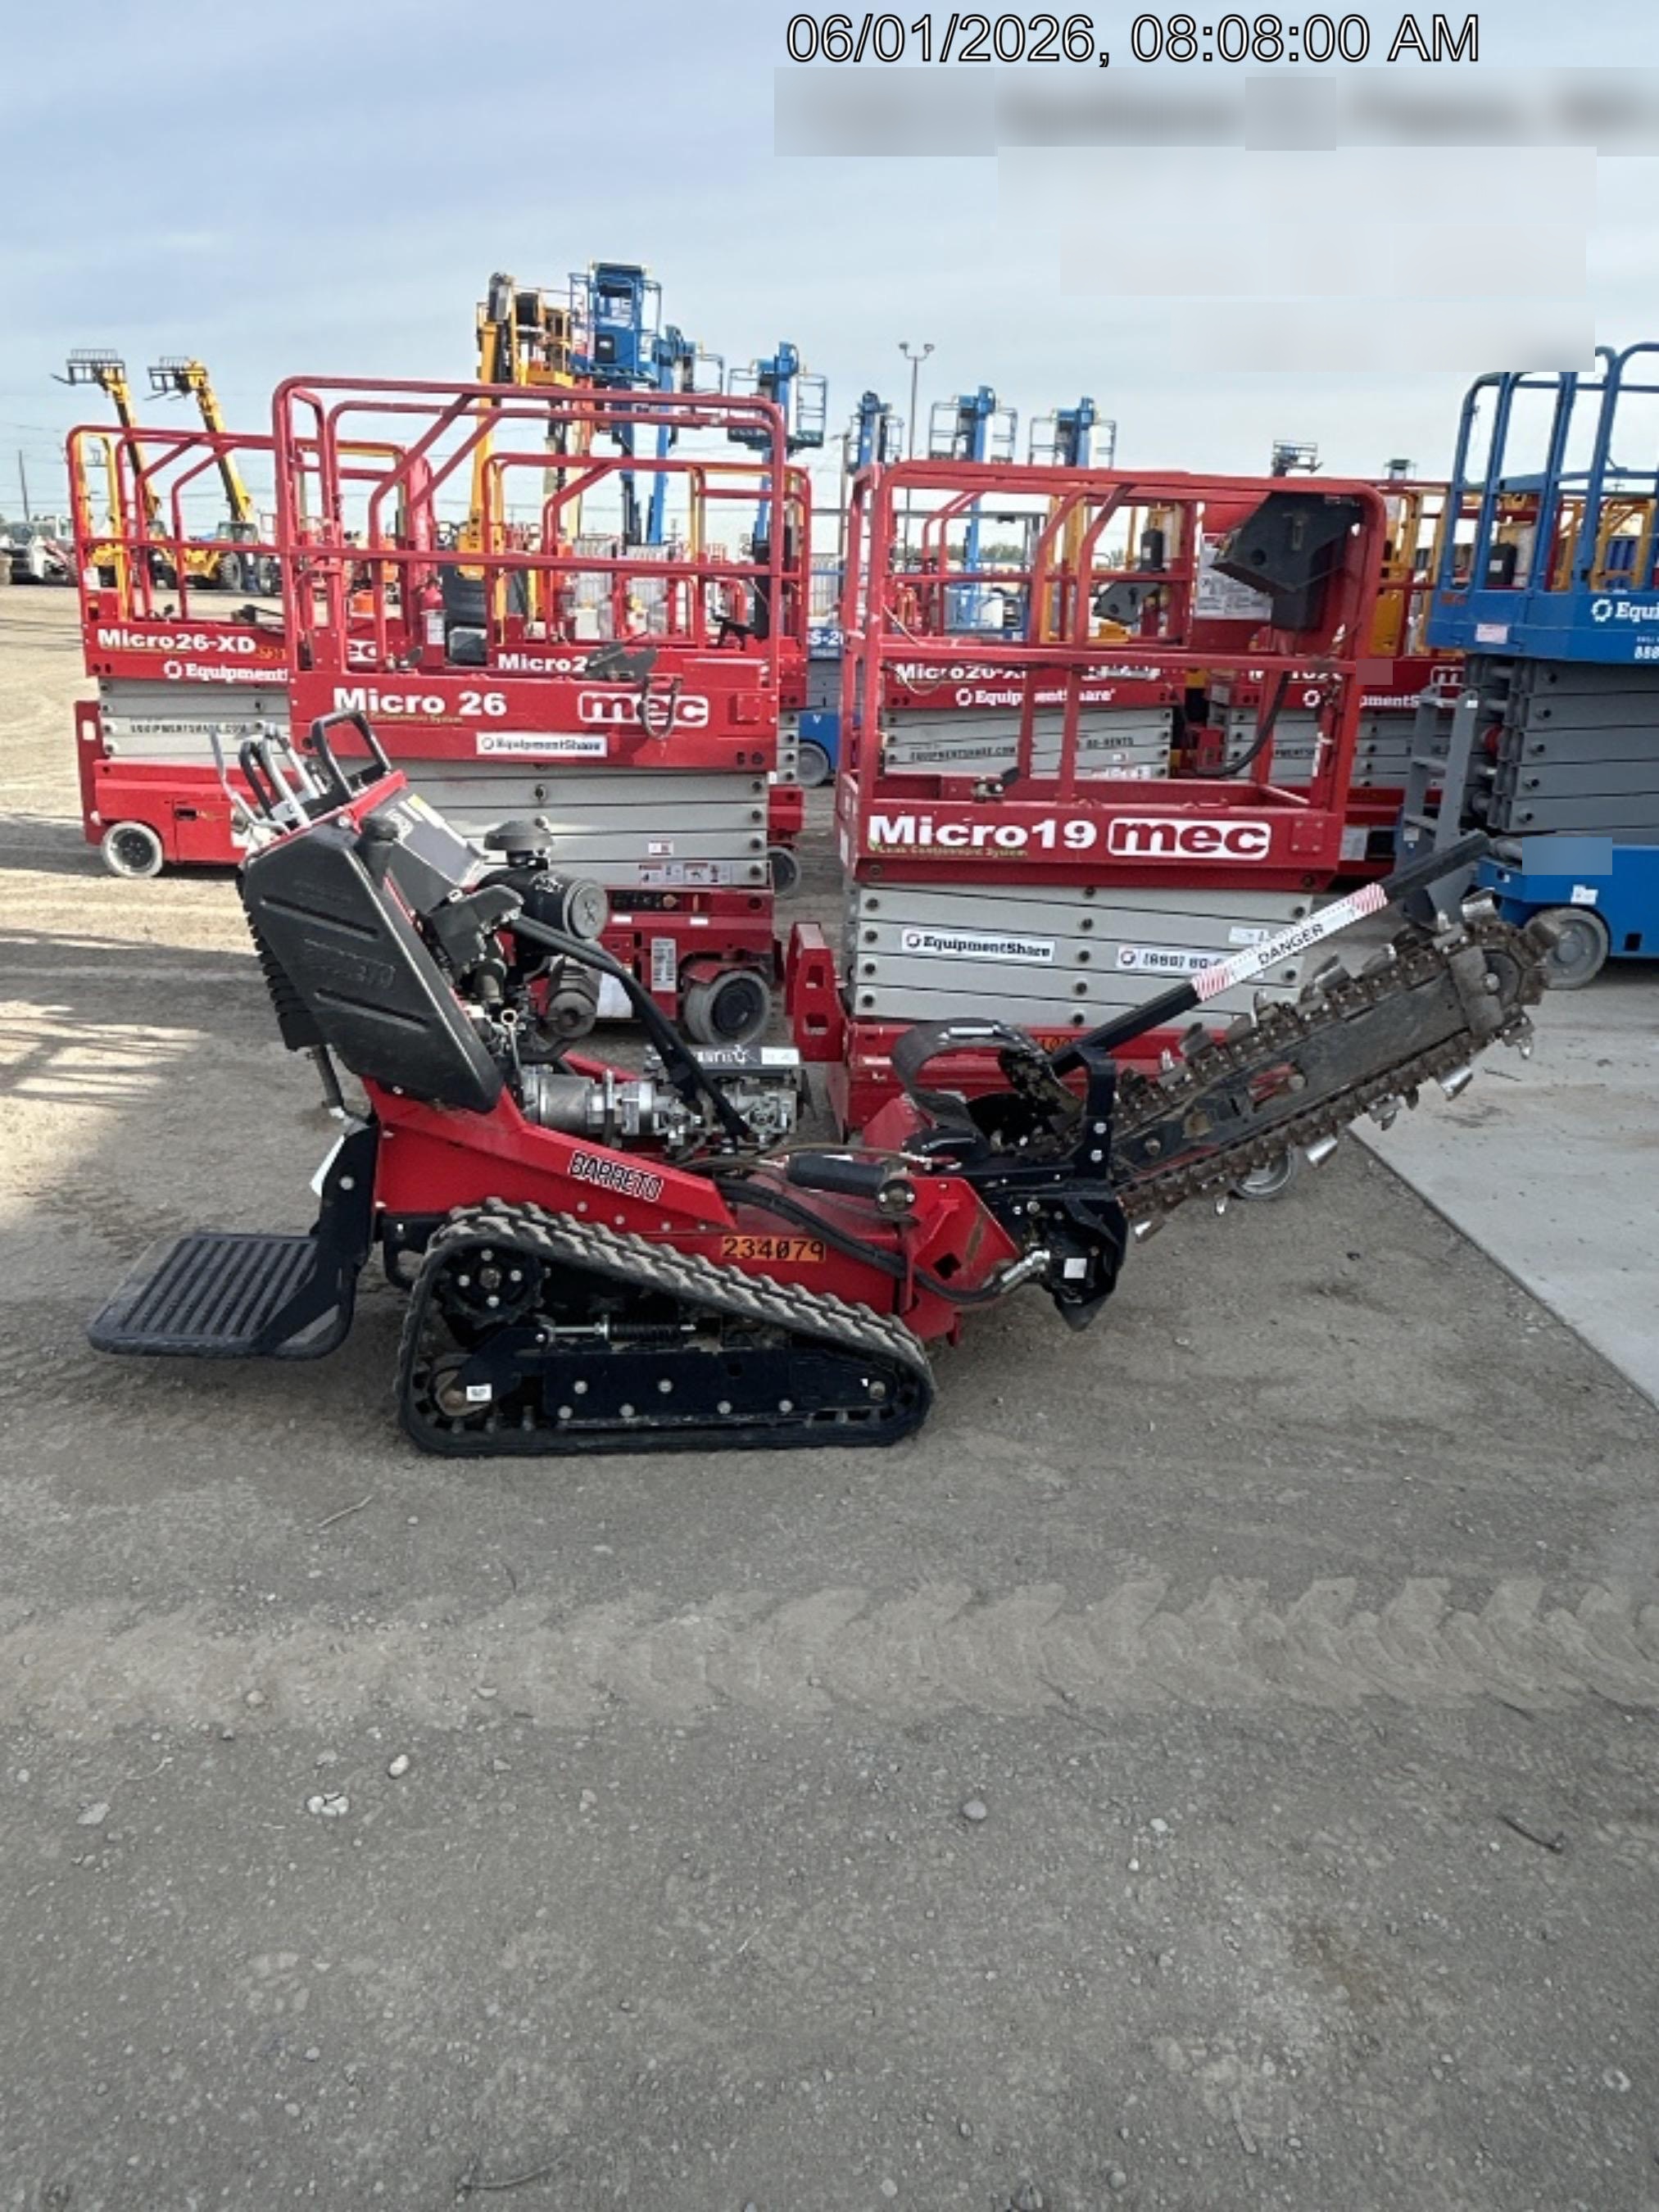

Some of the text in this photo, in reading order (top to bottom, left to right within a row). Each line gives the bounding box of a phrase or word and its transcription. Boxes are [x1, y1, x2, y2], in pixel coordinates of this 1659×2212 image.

[97, 628, 256, 654] Micro26-XD
[333, 687, 508, 716] Micro 26
[496, 739, 601, 751] EquipmentShare
[868, 815, 1098, 850] Micro19
[1112, 822, 1267, 854] mec
[923, 936, 1050, 958] EquipmentShare
[1258, 922, 1324, 966] DANGER
[569, 1149, 664, 1202] BARRETO
[723, 1238, 825, 1261] 234079
